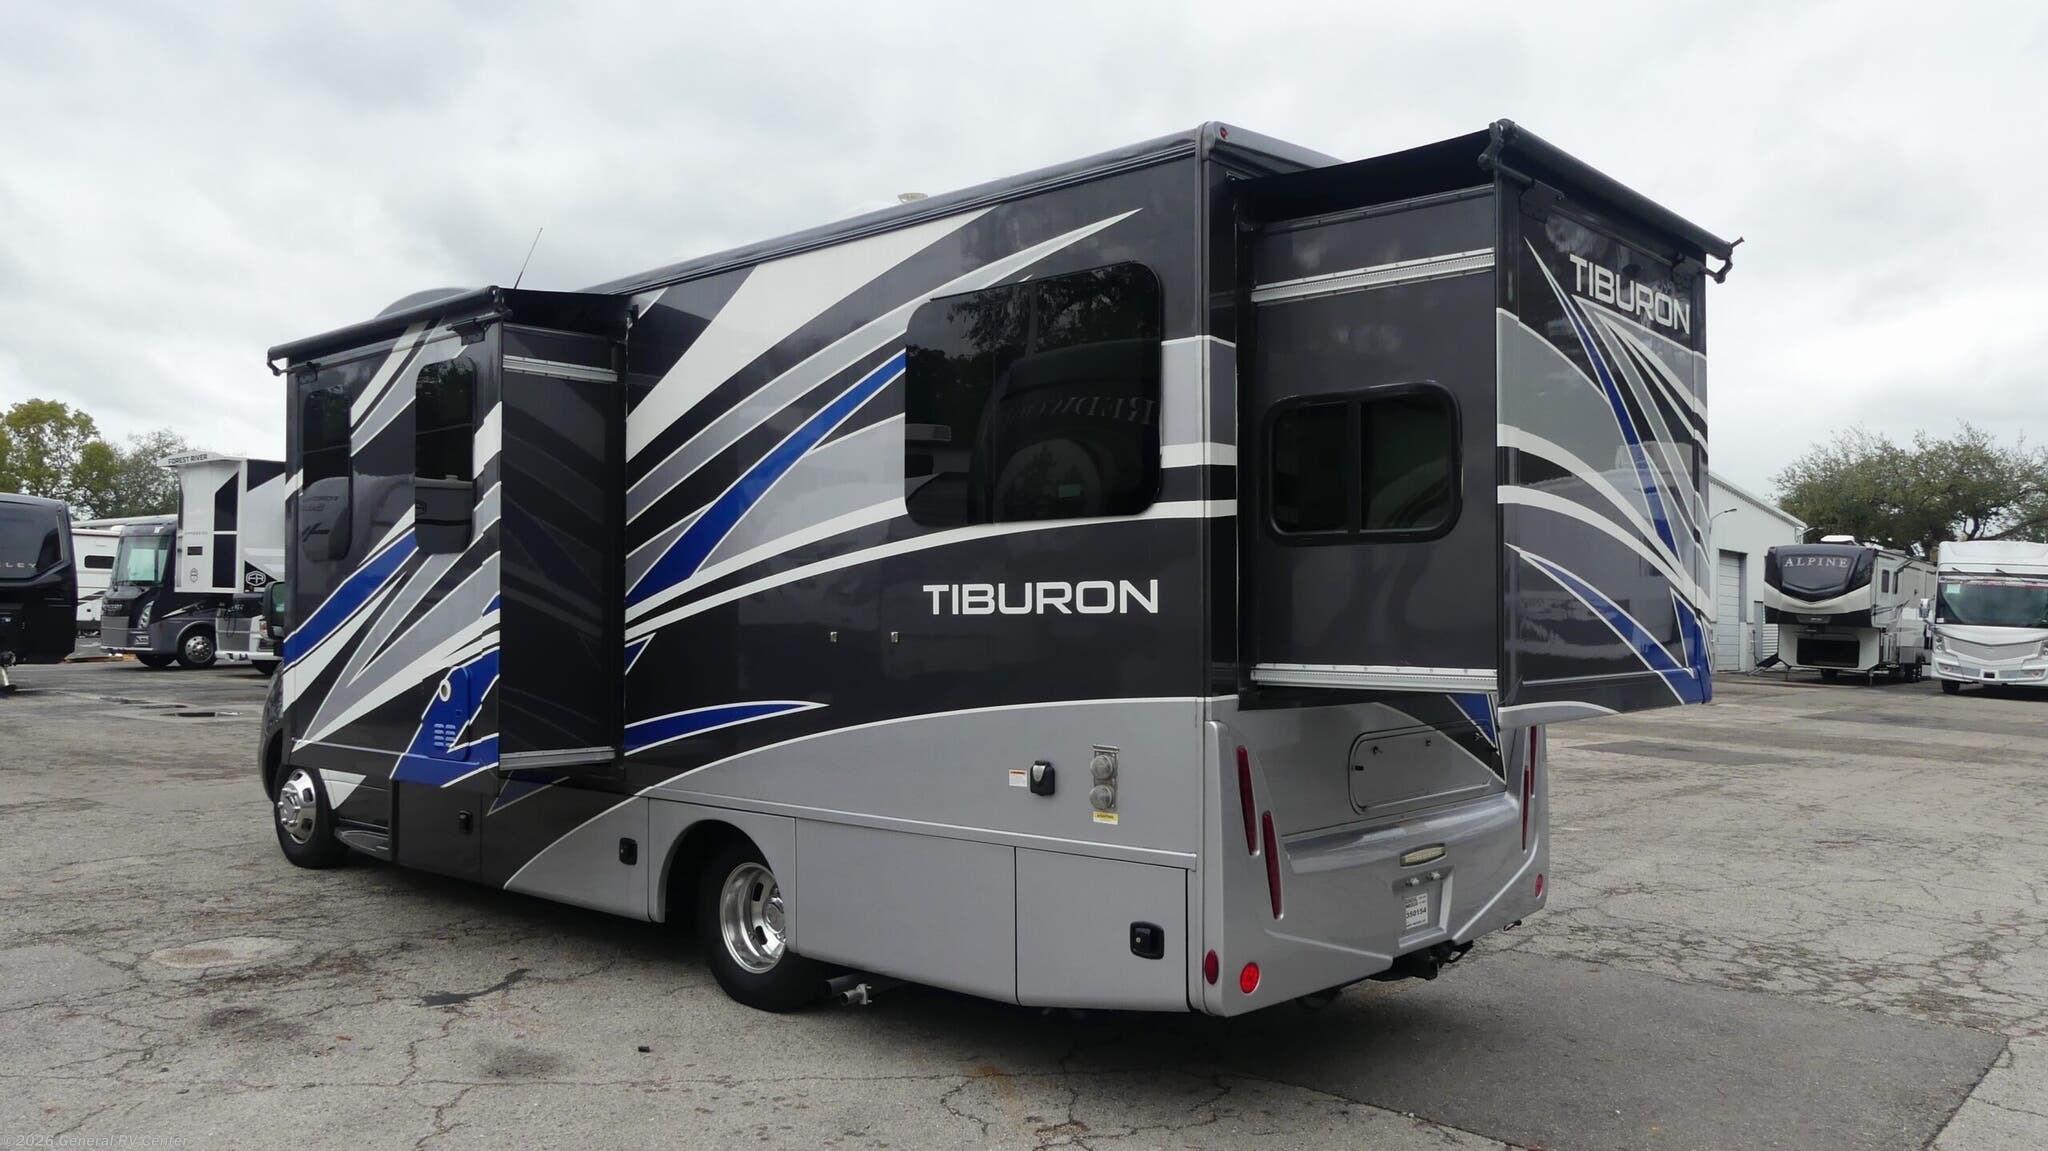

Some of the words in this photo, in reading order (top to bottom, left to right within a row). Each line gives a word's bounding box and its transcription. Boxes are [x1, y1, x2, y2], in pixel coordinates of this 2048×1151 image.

[1569, 253, 1690, 335] TIBURON
[167, 456, 190, 465] FOREST
[190, 453, 208, 461] RIVER
[1784, 557, 1848, 568] ALPINE
[922, 579, 1159, 616] TIBURON
